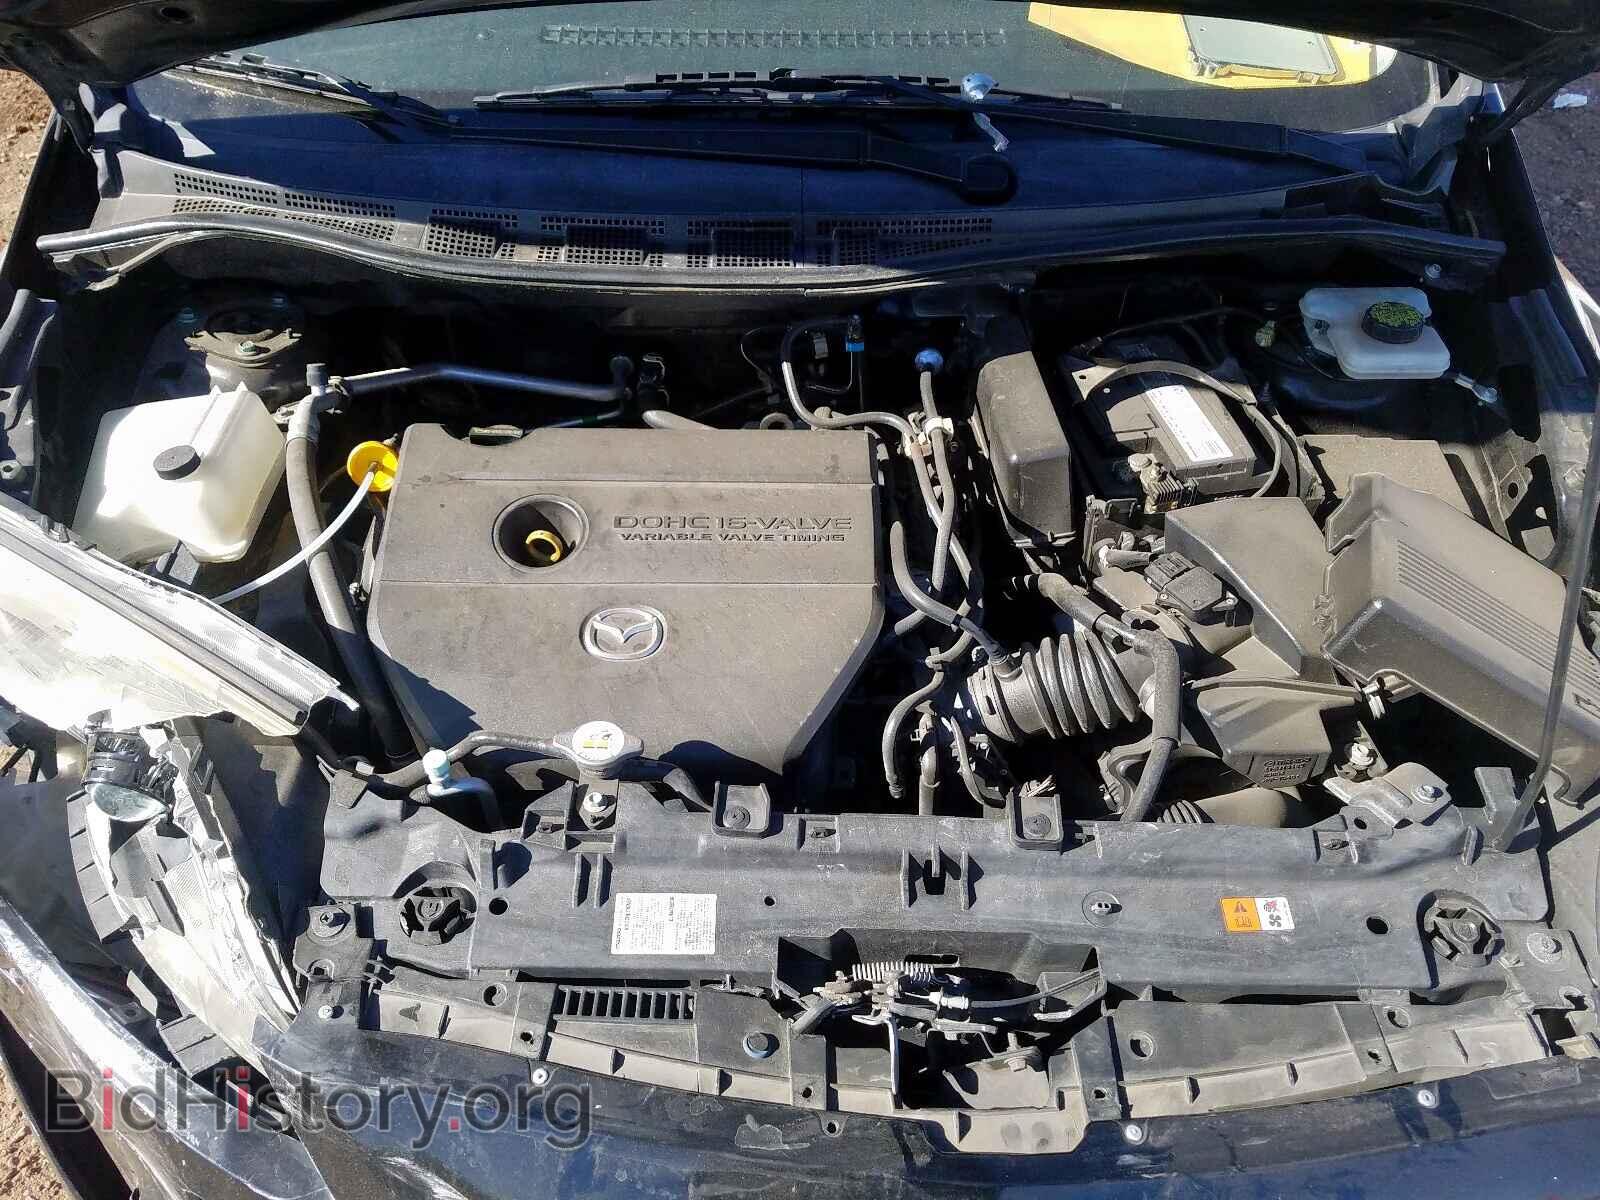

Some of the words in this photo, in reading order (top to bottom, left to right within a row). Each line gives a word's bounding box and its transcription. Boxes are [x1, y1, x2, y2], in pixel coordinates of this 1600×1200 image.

[613, 515, 710, 530] DOHC
[718, 516, 853, 531] 16-VALVE
[621, 532, 713, 541] VARIABLE
[719, 533, 775, 543] VALVE
[782, 533, 847, 543] TIMING
